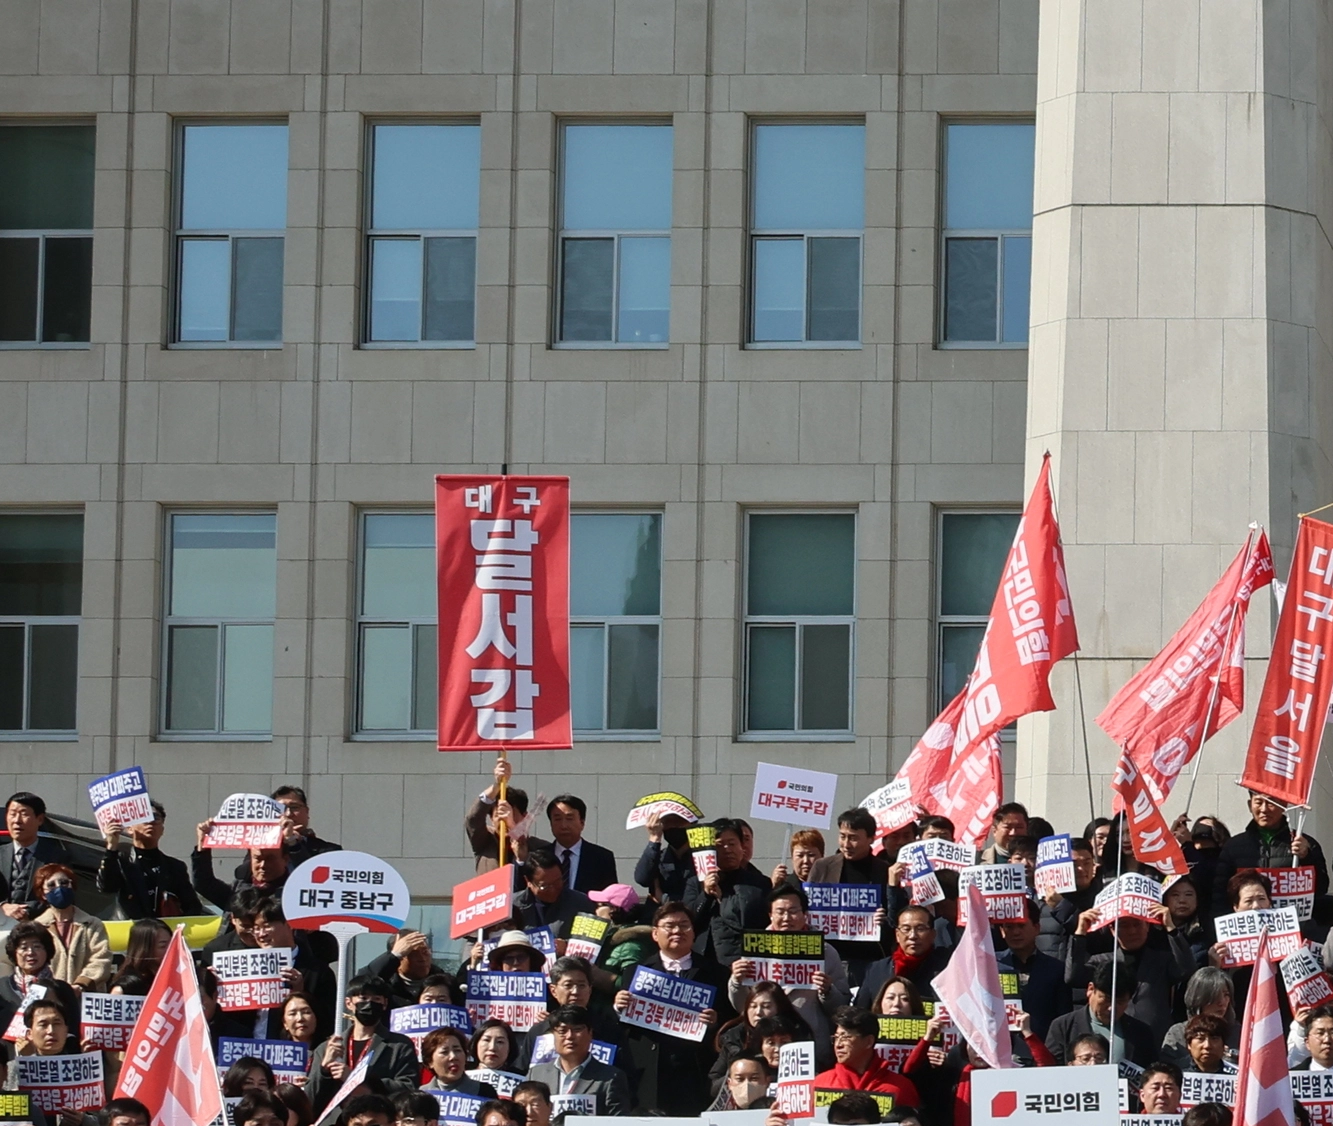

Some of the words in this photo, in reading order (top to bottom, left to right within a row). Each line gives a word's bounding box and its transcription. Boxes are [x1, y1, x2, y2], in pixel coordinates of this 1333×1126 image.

[1005, 544, 1050, 666] 국민의힘
[466, 517, 539, 741] 달서갑
[788, 782, 813, 793] 국민의힘
[759, 793, 828, 816] 대구북구갑
[332, 868, 384, 886] 국민의힘
[299, 890, 336, 909] 대구
[341, 890, 394, 912] 중남구
[455, 895, 507, 925] 대구북구갑
[1025, 1092, 1100, 1113] 국민의힘
